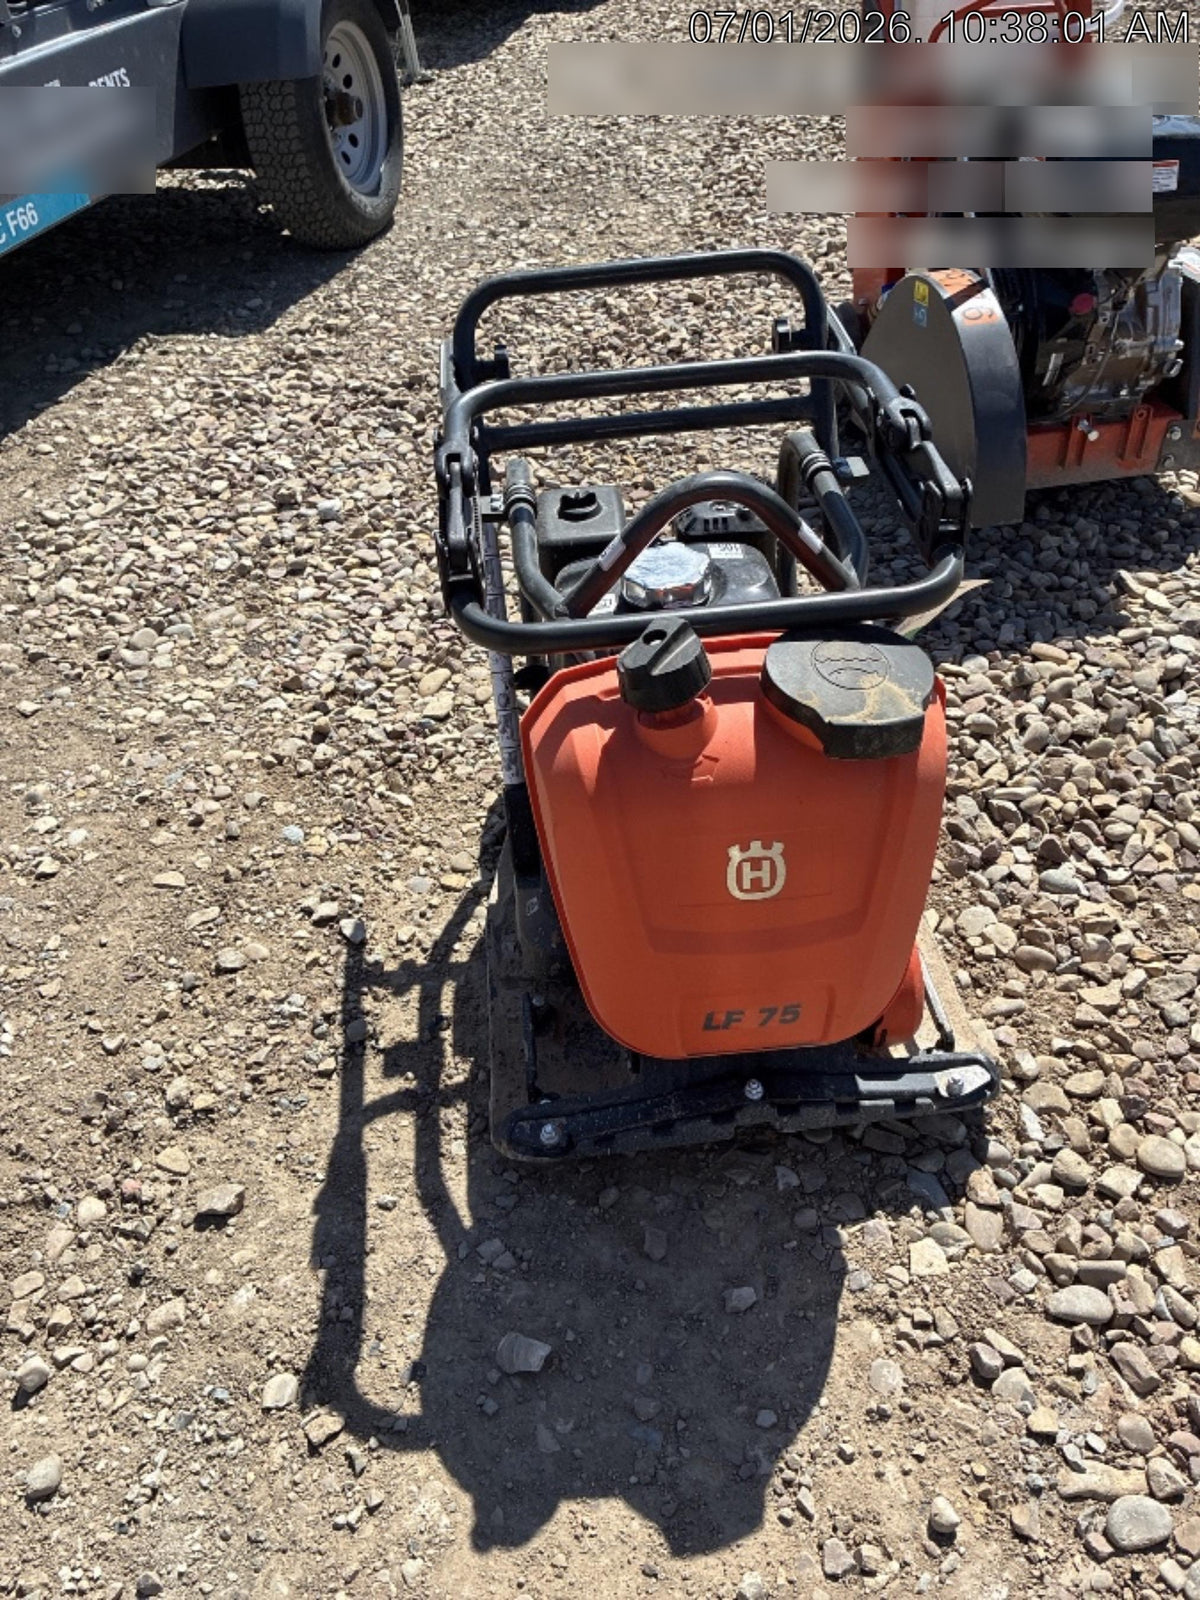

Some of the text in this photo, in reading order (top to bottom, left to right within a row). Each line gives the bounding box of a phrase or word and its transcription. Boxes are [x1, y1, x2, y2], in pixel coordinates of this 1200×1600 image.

[5, 202, 38, 237] F66
[703, 1004, 802, 1031] LF 75
